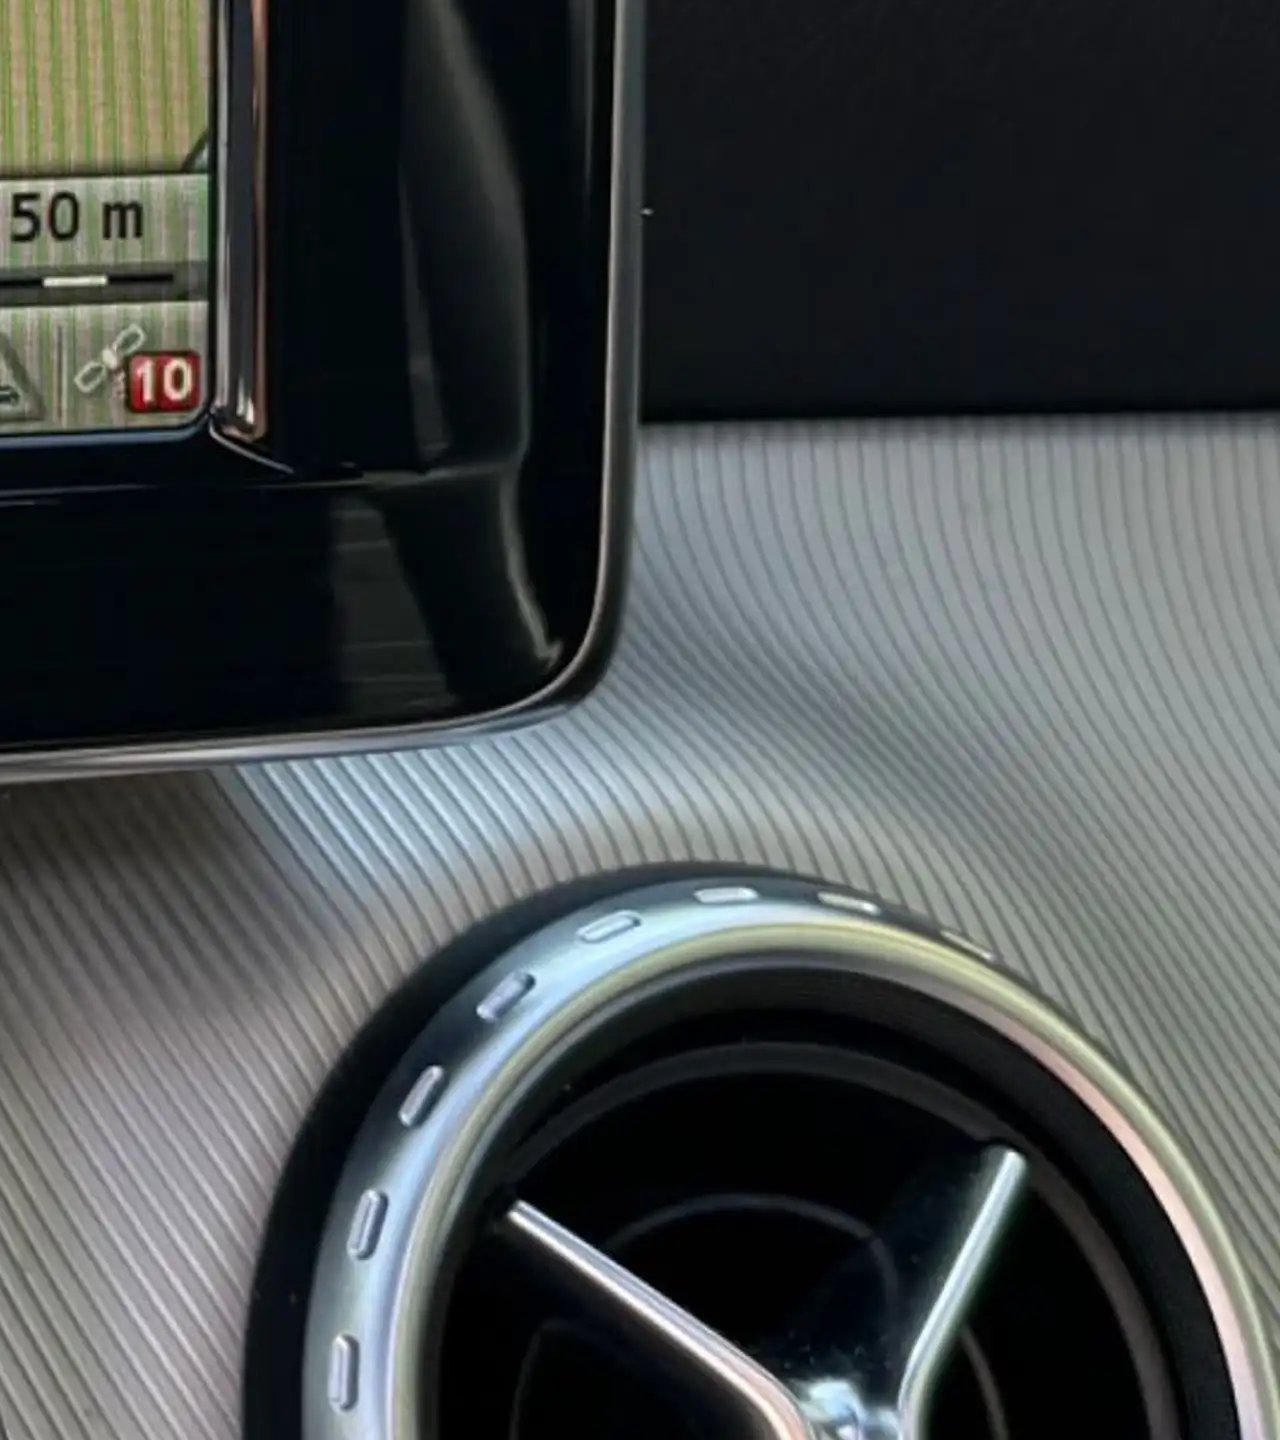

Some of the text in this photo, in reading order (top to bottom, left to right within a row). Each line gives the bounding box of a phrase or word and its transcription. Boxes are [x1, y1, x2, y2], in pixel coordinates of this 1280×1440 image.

[9, 190, 145, 243] 50 m
[134, 356, 194, 403] 10
